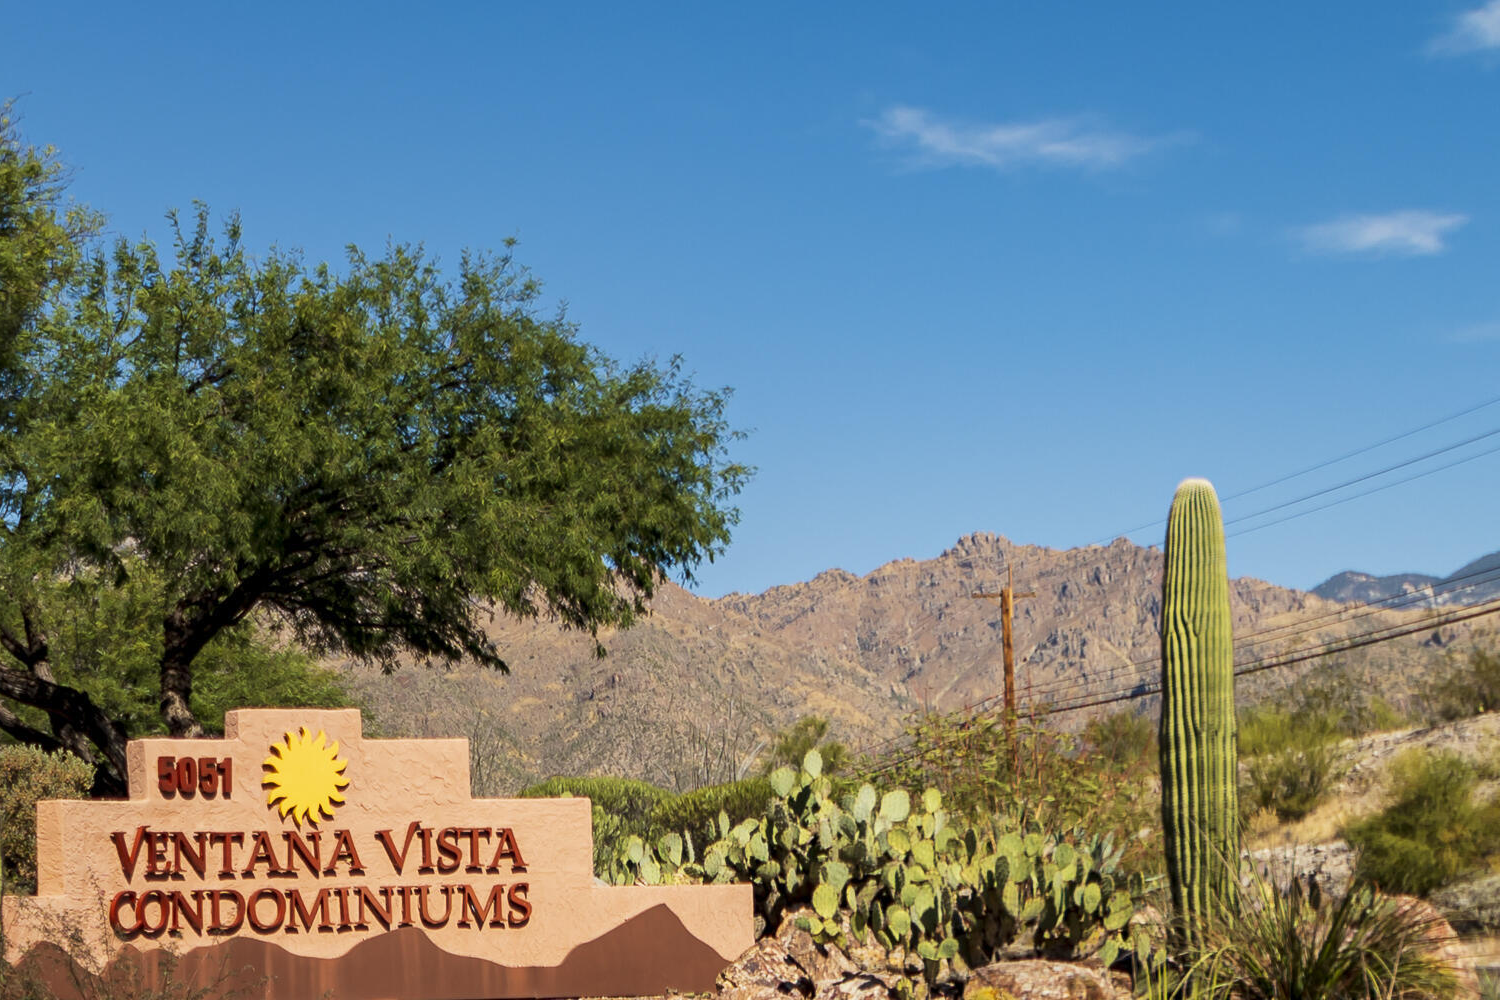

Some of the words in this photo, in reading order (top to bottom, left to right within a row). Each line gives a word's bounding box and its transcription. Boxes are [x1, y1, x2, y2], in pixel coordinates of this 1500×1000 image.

[157, 755, 233, 799] 5051
[110, 825, 368, 879] VENTANA
[375, 820, 530, 876] VISTA
[109, 882, 533, 938] CONDOMINIUMS
